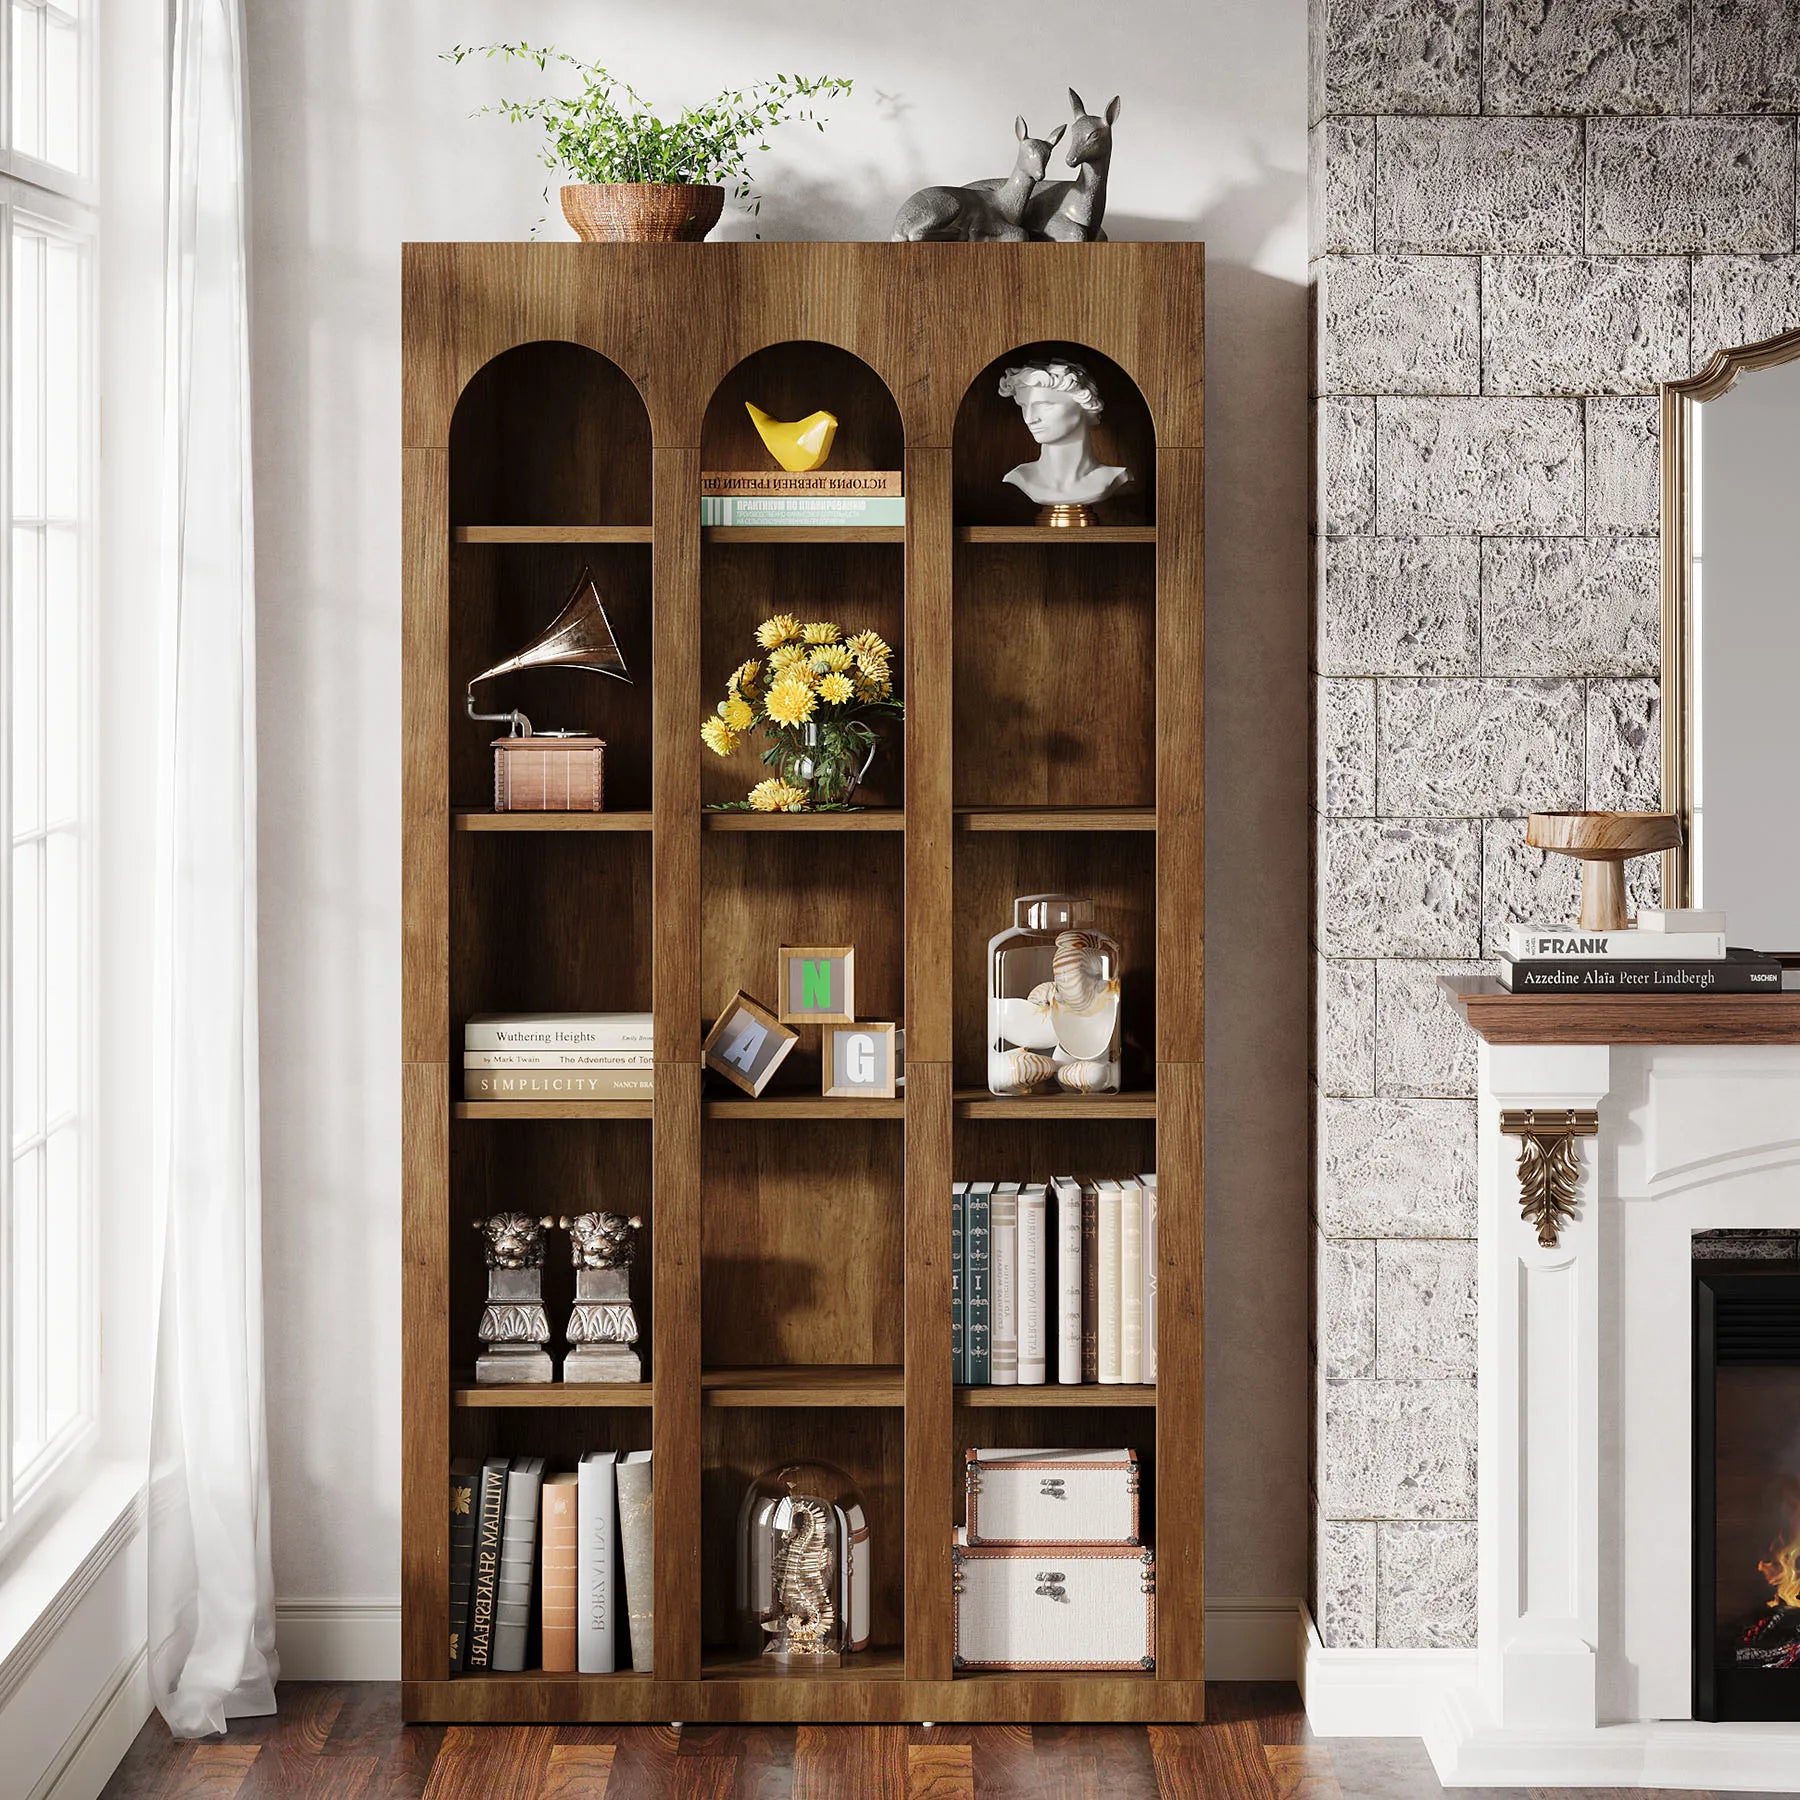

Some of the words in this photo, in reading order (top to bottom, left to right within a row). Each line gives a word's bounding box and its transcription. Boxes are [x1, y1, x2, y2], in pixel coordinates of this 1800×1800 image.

[723, 477, 770, 489] ГРЕЦИИ
[773, 477, 828, 491] ДРЕВНЕЙ
[829, 478, 887, 489] ИСТОРИЯ
[1539, 938, 1609, 954] FRANK
[803, 960, 831, 1008] N
[1524, 969, 1580, 984] Azzedine
[1583, 969, 1616, 984] Alaïa
[1620, 970, 1650, 984] Peter
[1653, 969, 1715, 988] Lindbergh
[1749, 974, 1778, 982] TASCHEN
[496, 1031, 552, 1044] Wuthering
[555, 1031, 596, 1044] Heights
[723, 1018, 769, 1073] A
[846, 1033, 875, 1083] G
[480, 1079, 599, 1090] SIMPLICITY
[613, 1080, 638, 1089] NANCY
